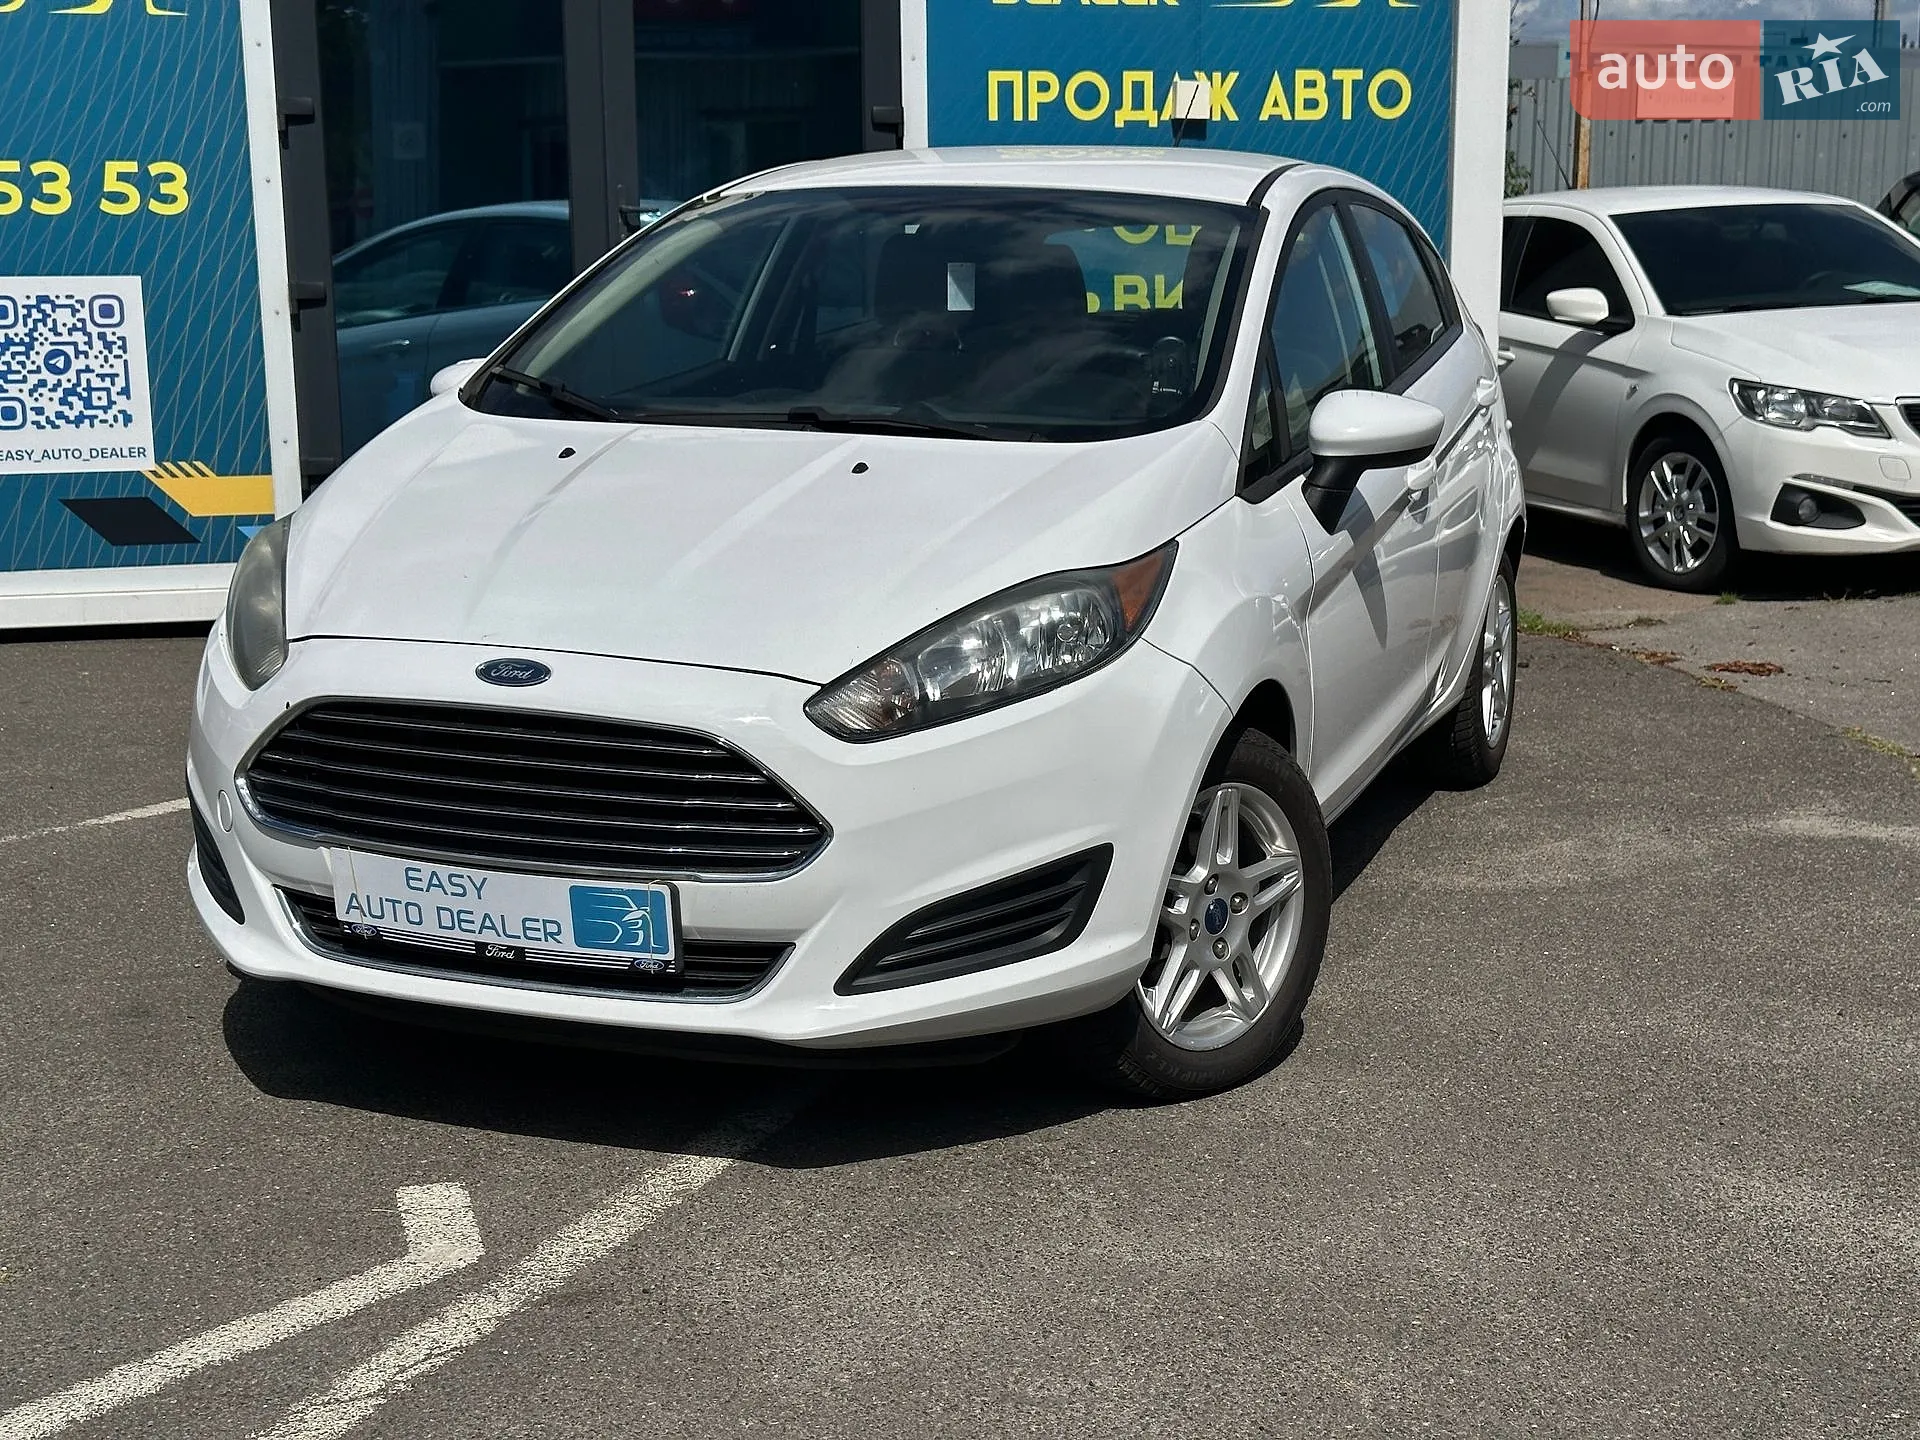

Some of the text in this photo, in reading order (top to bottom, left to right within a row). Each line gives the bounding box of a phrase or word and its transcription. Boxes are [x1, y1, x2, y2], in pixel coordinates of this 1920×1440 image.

[1259, 70, 1412, 121] АВТО
[99, 160, 190, 216] 53
[490, 662, 535, 680] Ford
[404, 866, 489, 901] EASY
[345, 892, 563, 945] AUTO DEALER
[485, 943, 516, 960] Ford
